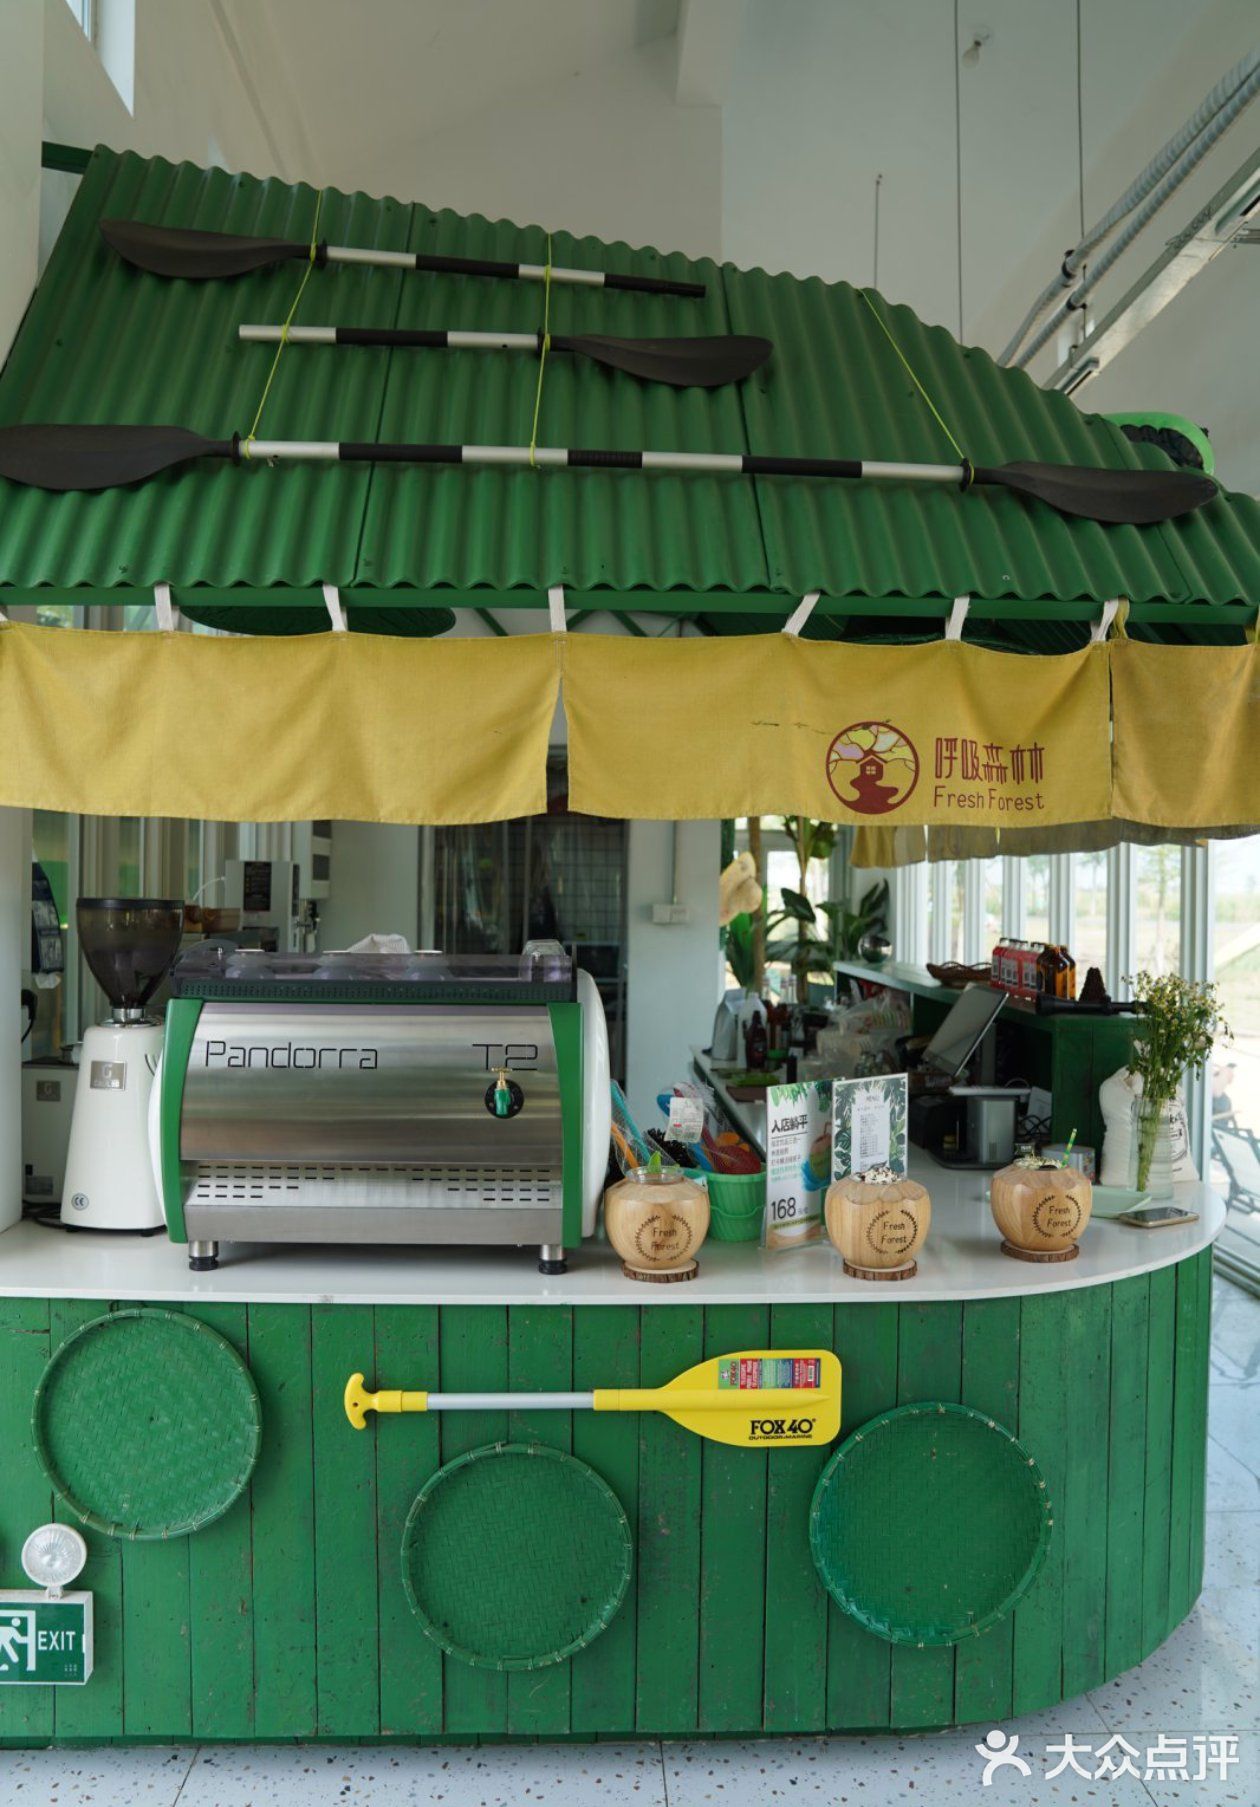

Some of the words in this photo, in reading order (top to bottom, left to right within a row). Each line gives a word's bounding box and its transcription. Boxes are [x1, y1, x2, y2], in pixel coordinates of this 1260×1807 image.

[934, 737, 1045, 785] 呼吸森林
[205, 1040, 379, 1071] Pandorra
[472, 1043, 539, 1072] T2
[770, 1196, 797, 1221] 168
[1048, 1205, 1071, 1215] Fresh
[883, 1221, 906, 1231] Fresh
[1046, 1217, 1073, 1228] Forest
[652, 1226, 677, 1238] Fresh
[880, 1234, 908, 1245] Forest
[750, 1419, 787, 1435] FOX
[37, 1630, 76, 1651] EXIT
